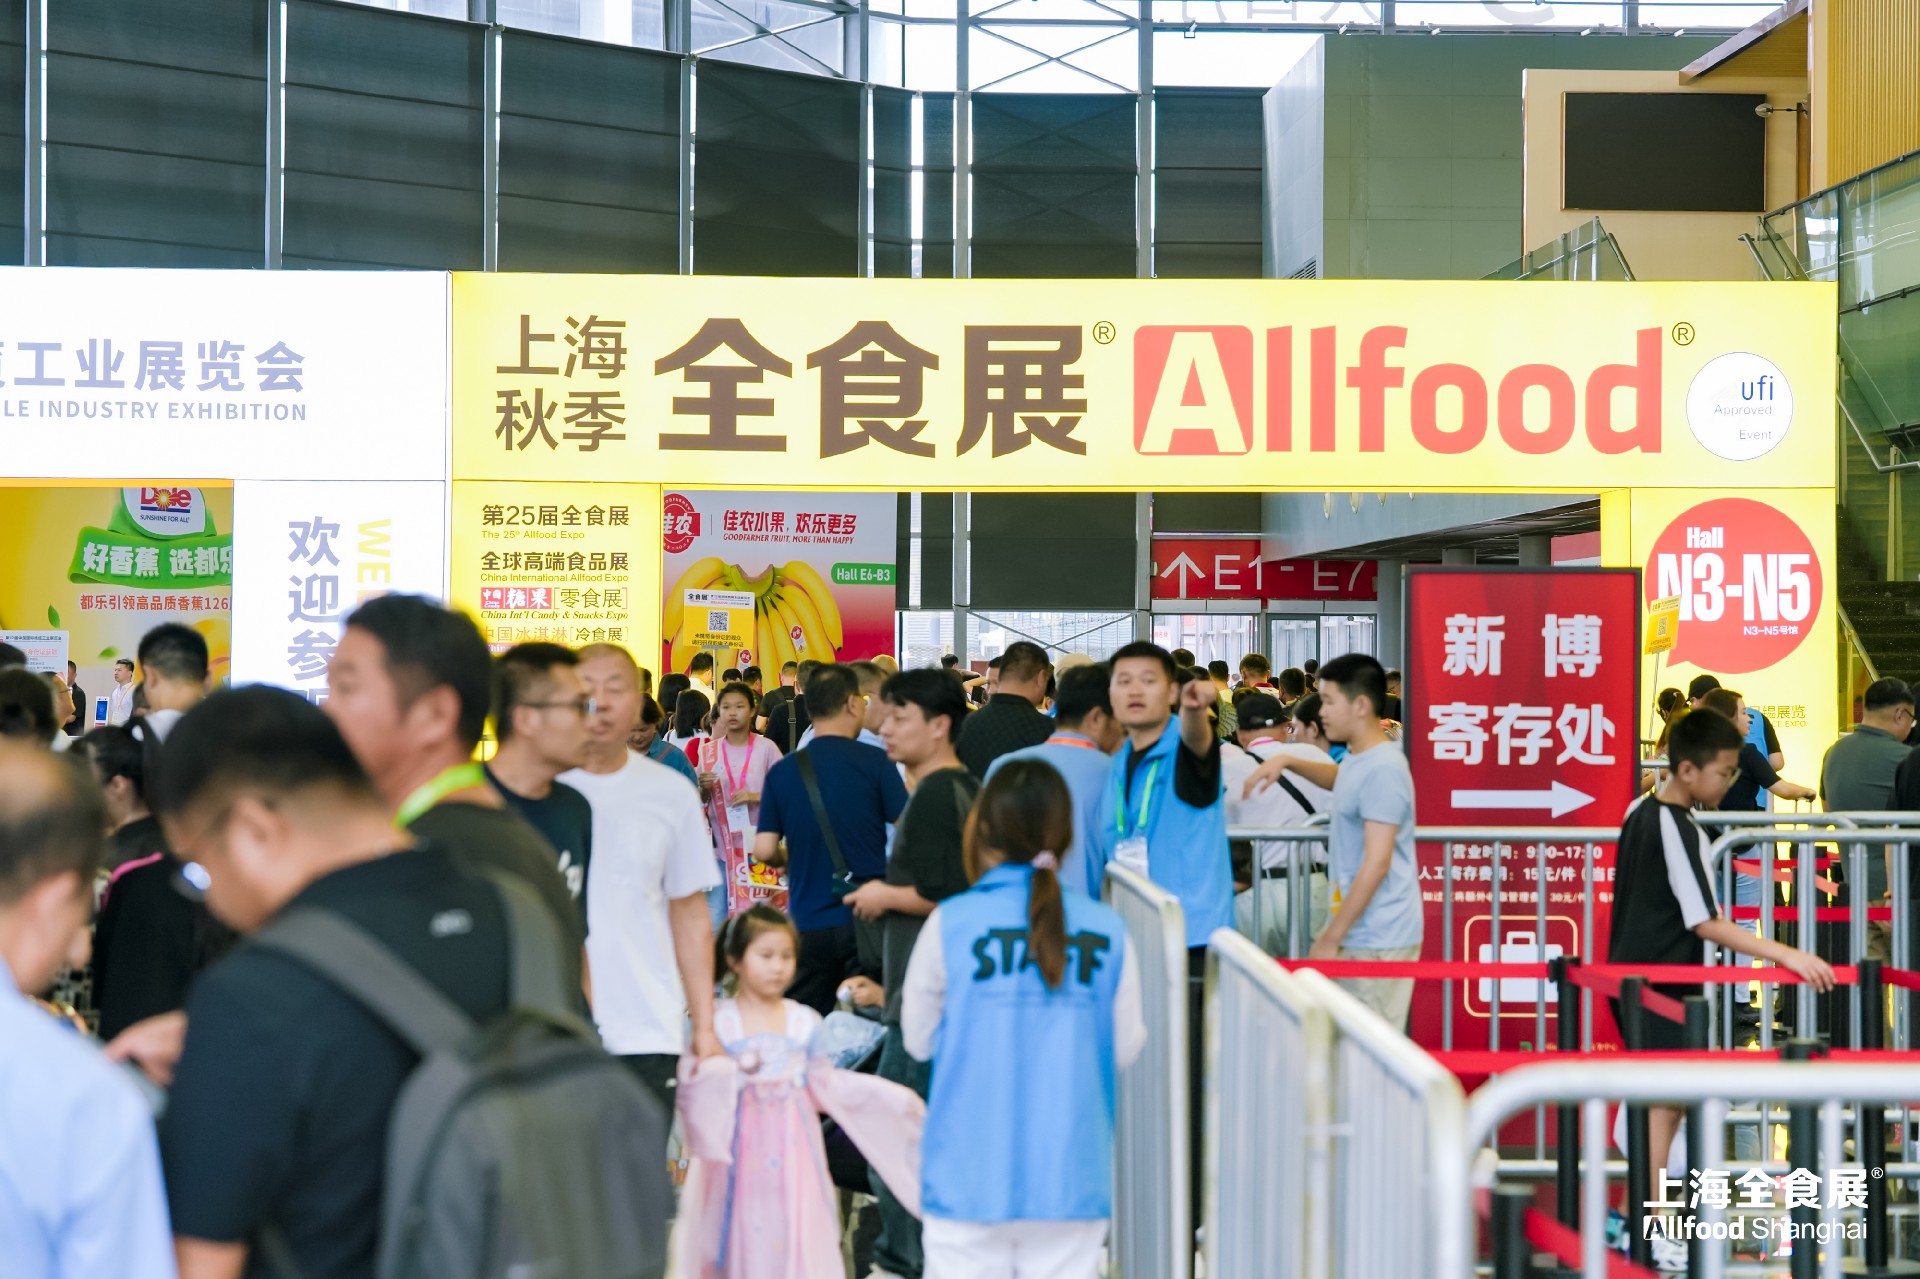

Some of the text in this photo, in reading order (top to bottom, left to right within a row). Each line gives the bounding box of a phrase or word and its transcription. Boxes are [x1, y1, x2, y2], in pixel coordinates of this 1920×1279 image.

[496, 314, 627, 379] 上海
[1741, 375, 1774, 401] ufi
[39, 400, 159, 419] INDUSTRY
[168, 402, 307, 421] EXHIBITION
[495, 387, 627, 452] 秋季
[1714, 404, 1772, 416] Approved
[1739, 429, 1772, 440] Event
[140, 514, 167, 522] SUNSHINE
[482, 504, 630, 527] 第25届全食展
[481, 530, 500, 539] The
[524, 530, 557, 539] Allfood
[560, 531, 585, 540] Expo
[723, 533, 769, 542] GOODFARMER
[792, 535, 811, 543] MORE
[812, 536, 831, 544] THAN
[832, 536, 854, 545] HAPPY
[1686, 527, 1724, 549] Hall
[83, 541, 160, 577] 好香蕉
[357, 518, 392, 604] WE
[480, 551, 629, 571] 全球高端食品展
[480, 573, 629, 584] China International Allfood Expo
[837, 568, 891, 582] Hall E6-B3
[1657, 552, 1811, 622] N3-N5
[80, 594, 232, 611] 都乐引领高品质香蕉126
[287, 516, 340, 704] 欢迎参
[481, 610, 507, 619] China
[531, 610, 560, 621] Candy
[562, 611, 570, 619] &
[572, 610, 604, 619] Snacks
[606, 611, 628, 622] Expo
[1743, 625, 1799, 636] N3-N5号馆
[1427, 701, 1617, 766] 寄存处
